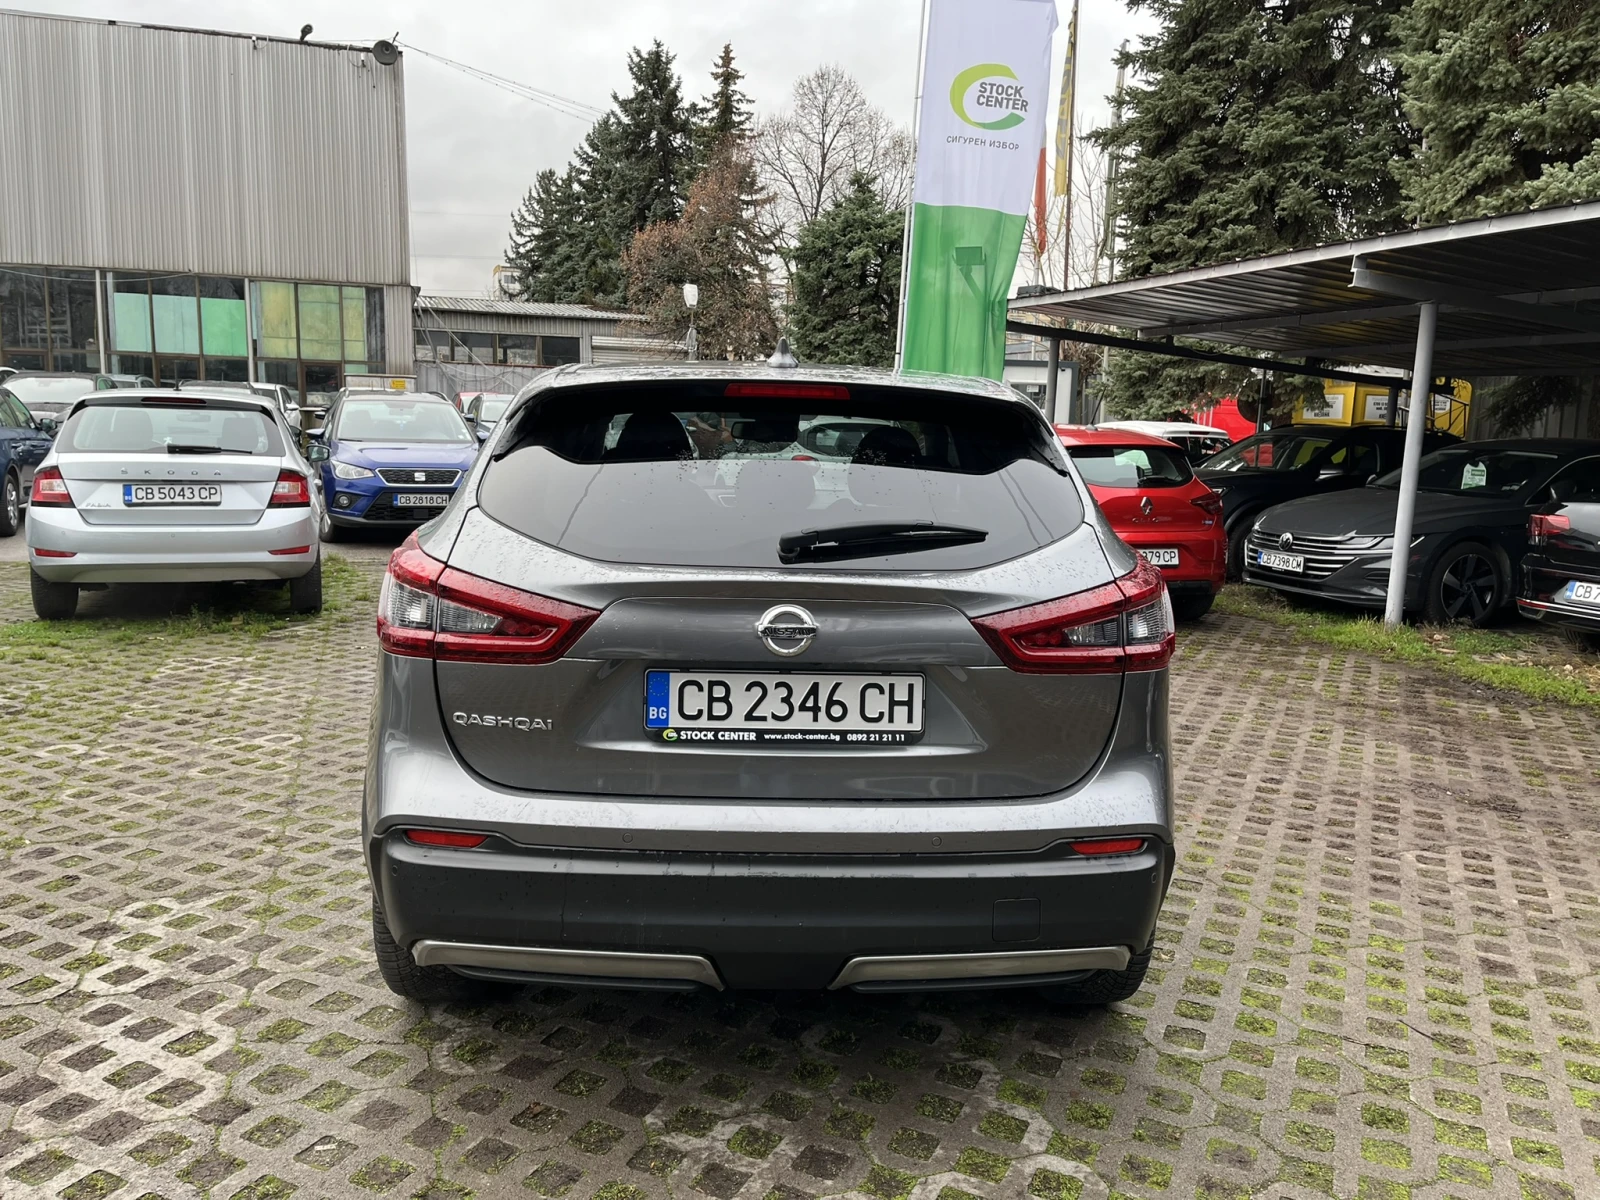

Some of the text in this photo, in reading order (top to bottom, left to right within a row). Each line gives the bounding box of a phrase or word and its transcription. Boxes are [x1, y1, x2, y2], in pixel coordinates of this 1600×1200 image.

[978, 82, 1024, 98] STOCK
[976, 94, 1029, 112] CENTER
[946, 135, 1020, 151] СИГУРЕН ИЗБОР
[134, 487, 155, 500] CB
[158, 487, 196, 500] 5043
[198, 487, 218, 500] CP
[399, 495, 411, 505] CB
[412, 495, 434, 505] 2818
[435, 495, 448, 505] CH
[1162, 550, 1177, 563] CP
[1271, 554, 1291, 568] 7398
[1574, 584, 1593, 599] CB
[764, 626, 811, 637] NISSAN
[677, 679, 914, 724] CB 2346 CH
[649, 706, 667, 719] BG
[680, 730, 905, 742] STOCK CENTER www.stock-center.bg 0892 21 21 11
